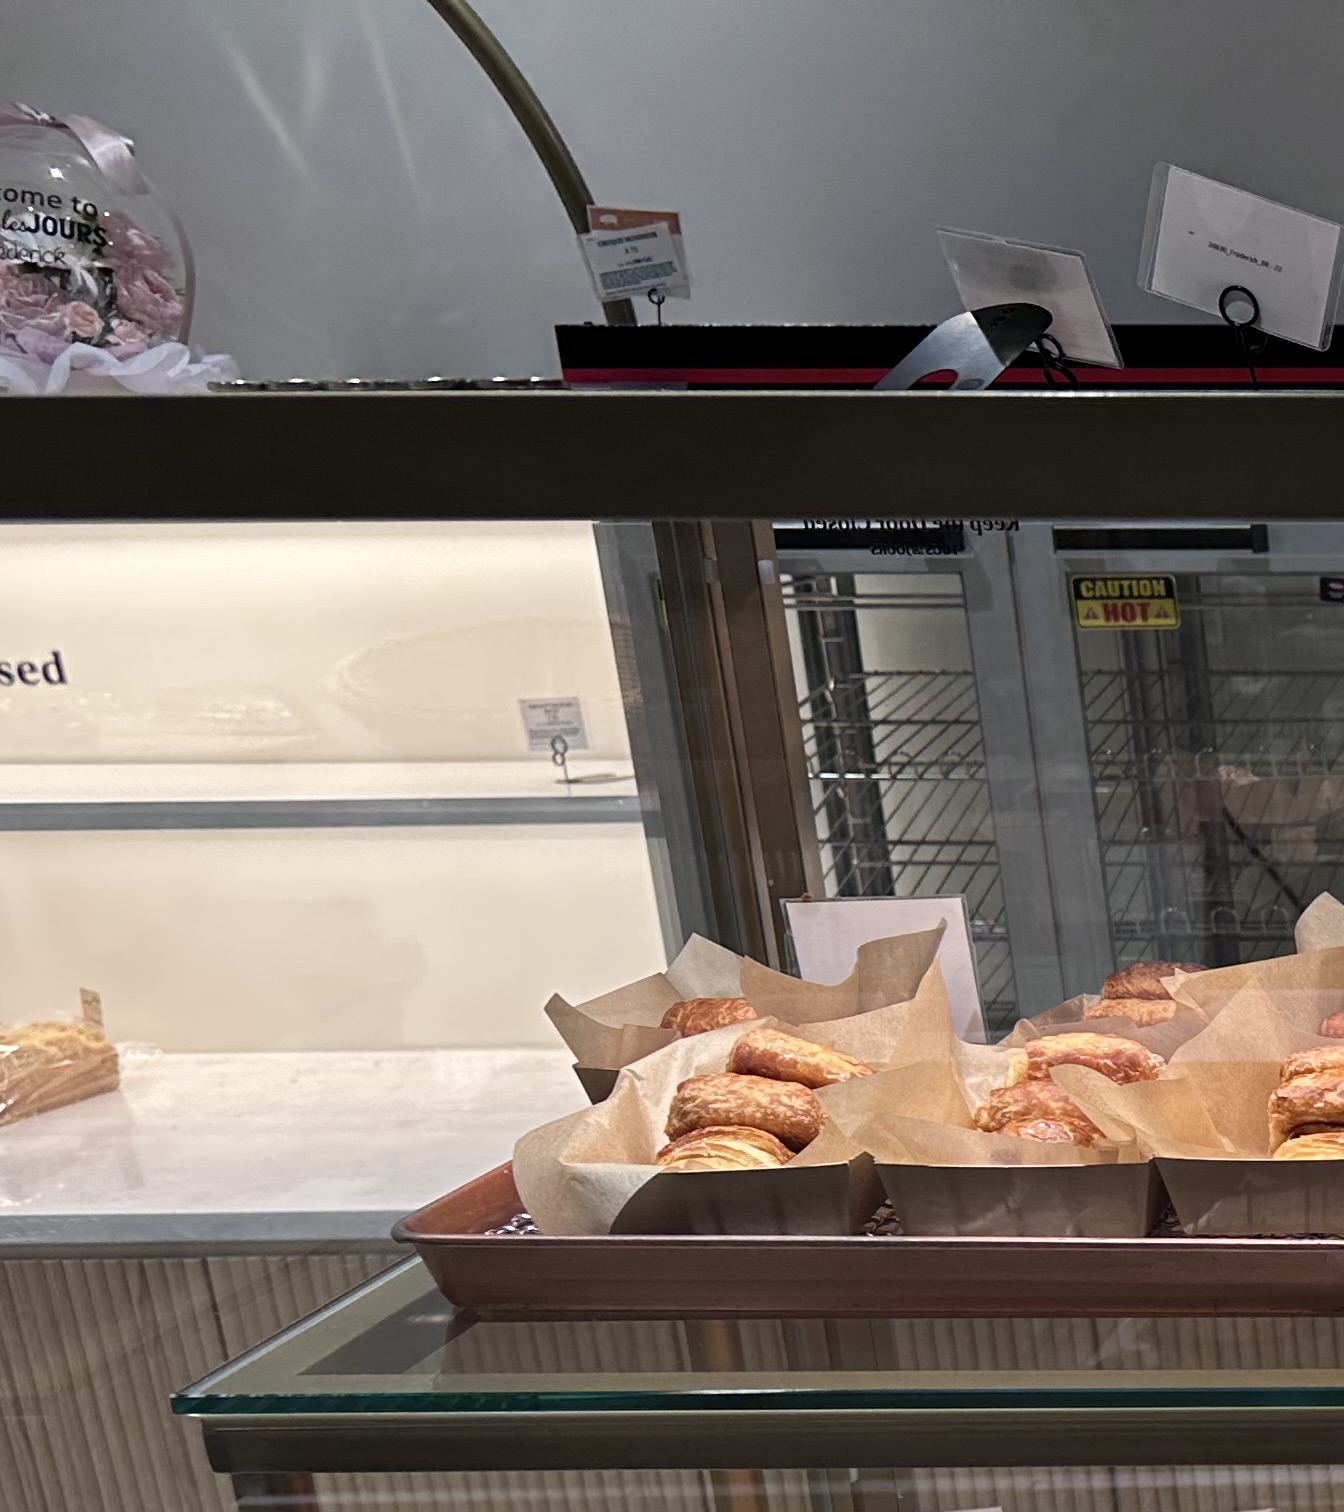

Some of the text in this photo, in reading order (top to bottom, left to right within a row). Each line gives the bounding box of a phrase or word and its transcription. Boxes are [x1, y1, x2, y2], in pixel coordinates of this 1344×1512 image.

[0, 187, 98, 218] ome to
[1080, 580, 1166, 598] CAUTION
[1102, 602, 1151, 623] HOT
